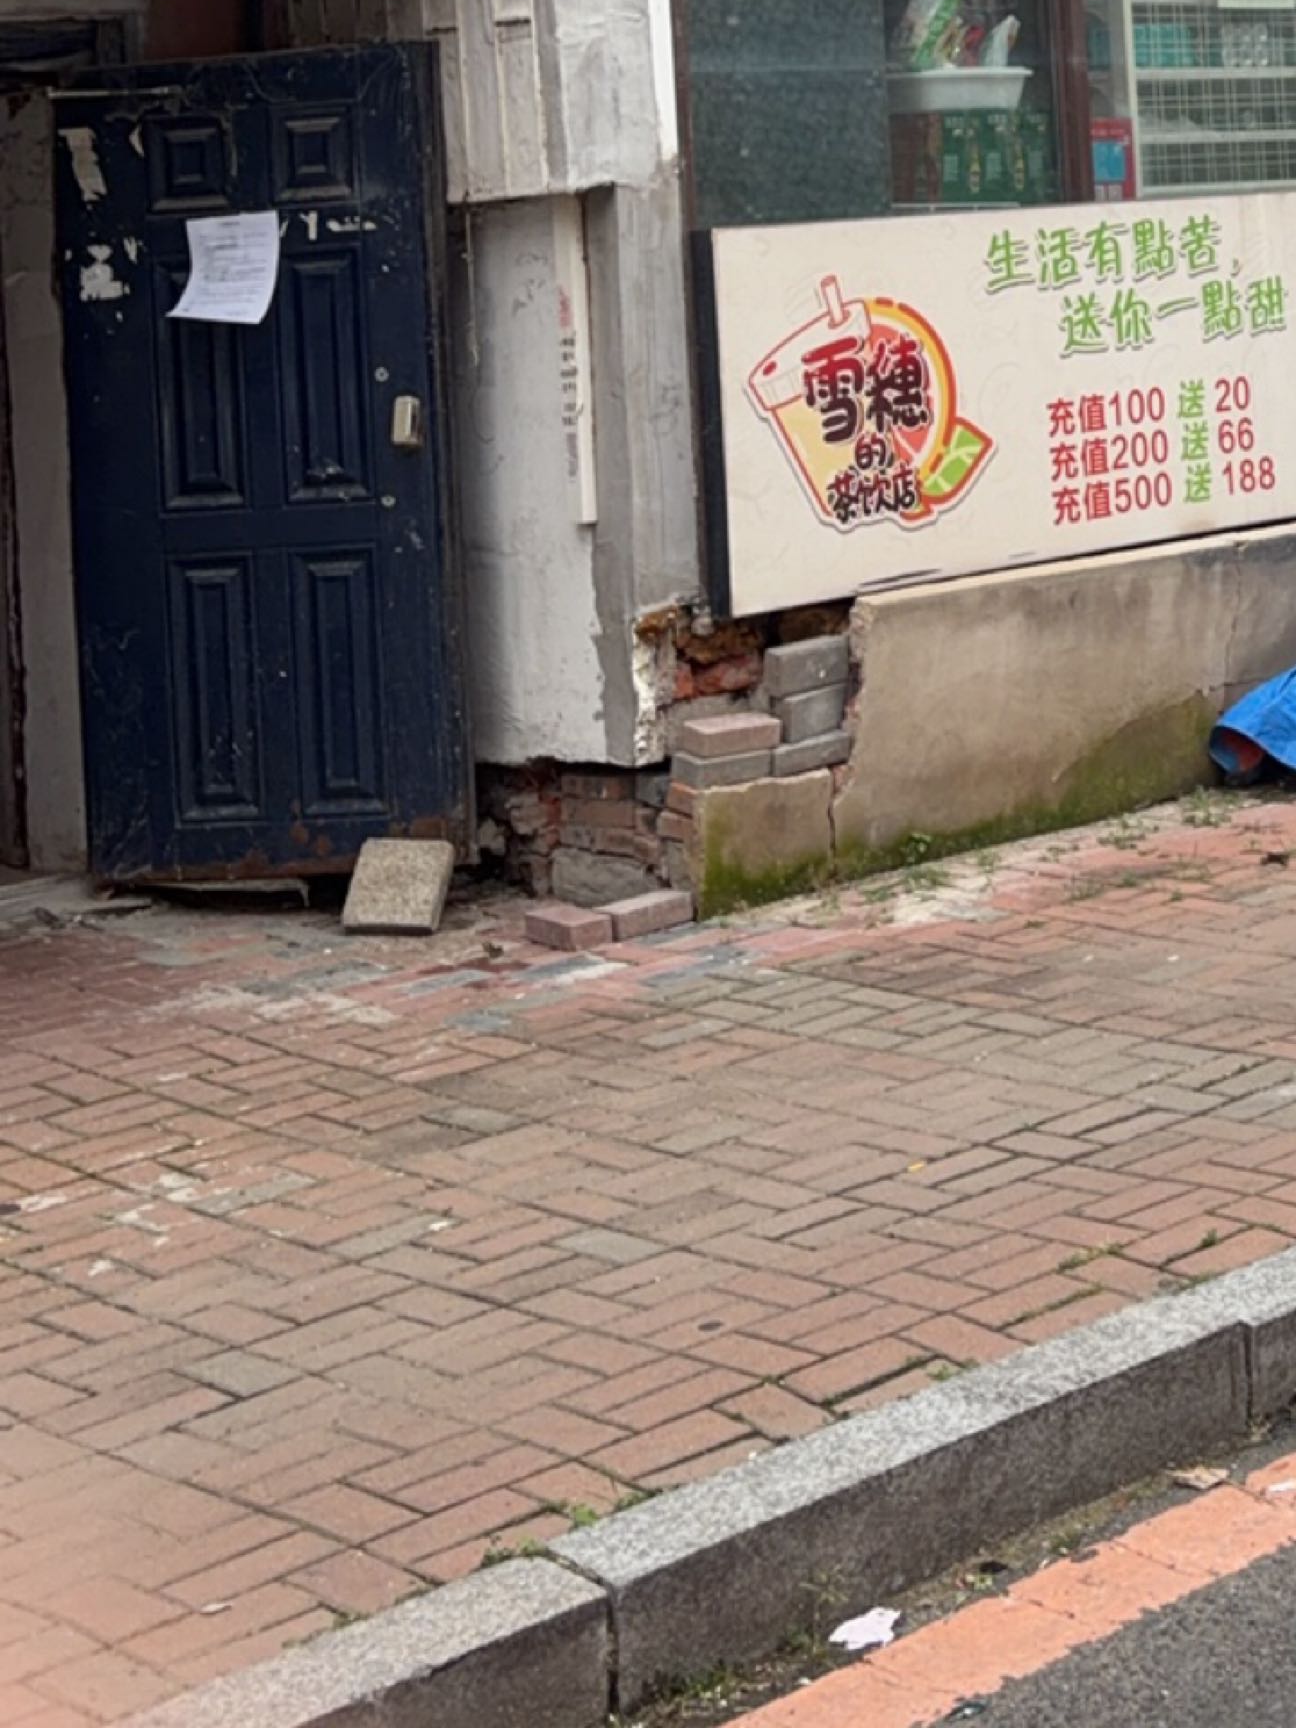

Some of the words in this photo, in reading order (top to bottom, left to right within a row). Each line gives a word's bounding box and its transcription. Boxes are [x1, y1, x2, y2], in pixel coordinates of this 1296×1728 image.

[1058, 274, 1288, 359] 送你一點甜
[1046, 386, 1166, 439] 充值100
[1176, 378, 1207, 419] 送
[1214, 375, 1251, 414] 20
[854, 433, 893, 471] 的
[1049, 429, 1170, 482] 充值200
[1180, 421, 1210, 462] 送
[1217, 417, 1255, 455] 66
[826, 464, 921, 523] 茶饮店
[1051, 472, 1173, 526] 充值500
[1183, 462, 1214, 504] 送
[1222, 455, 1276, 496] 188
